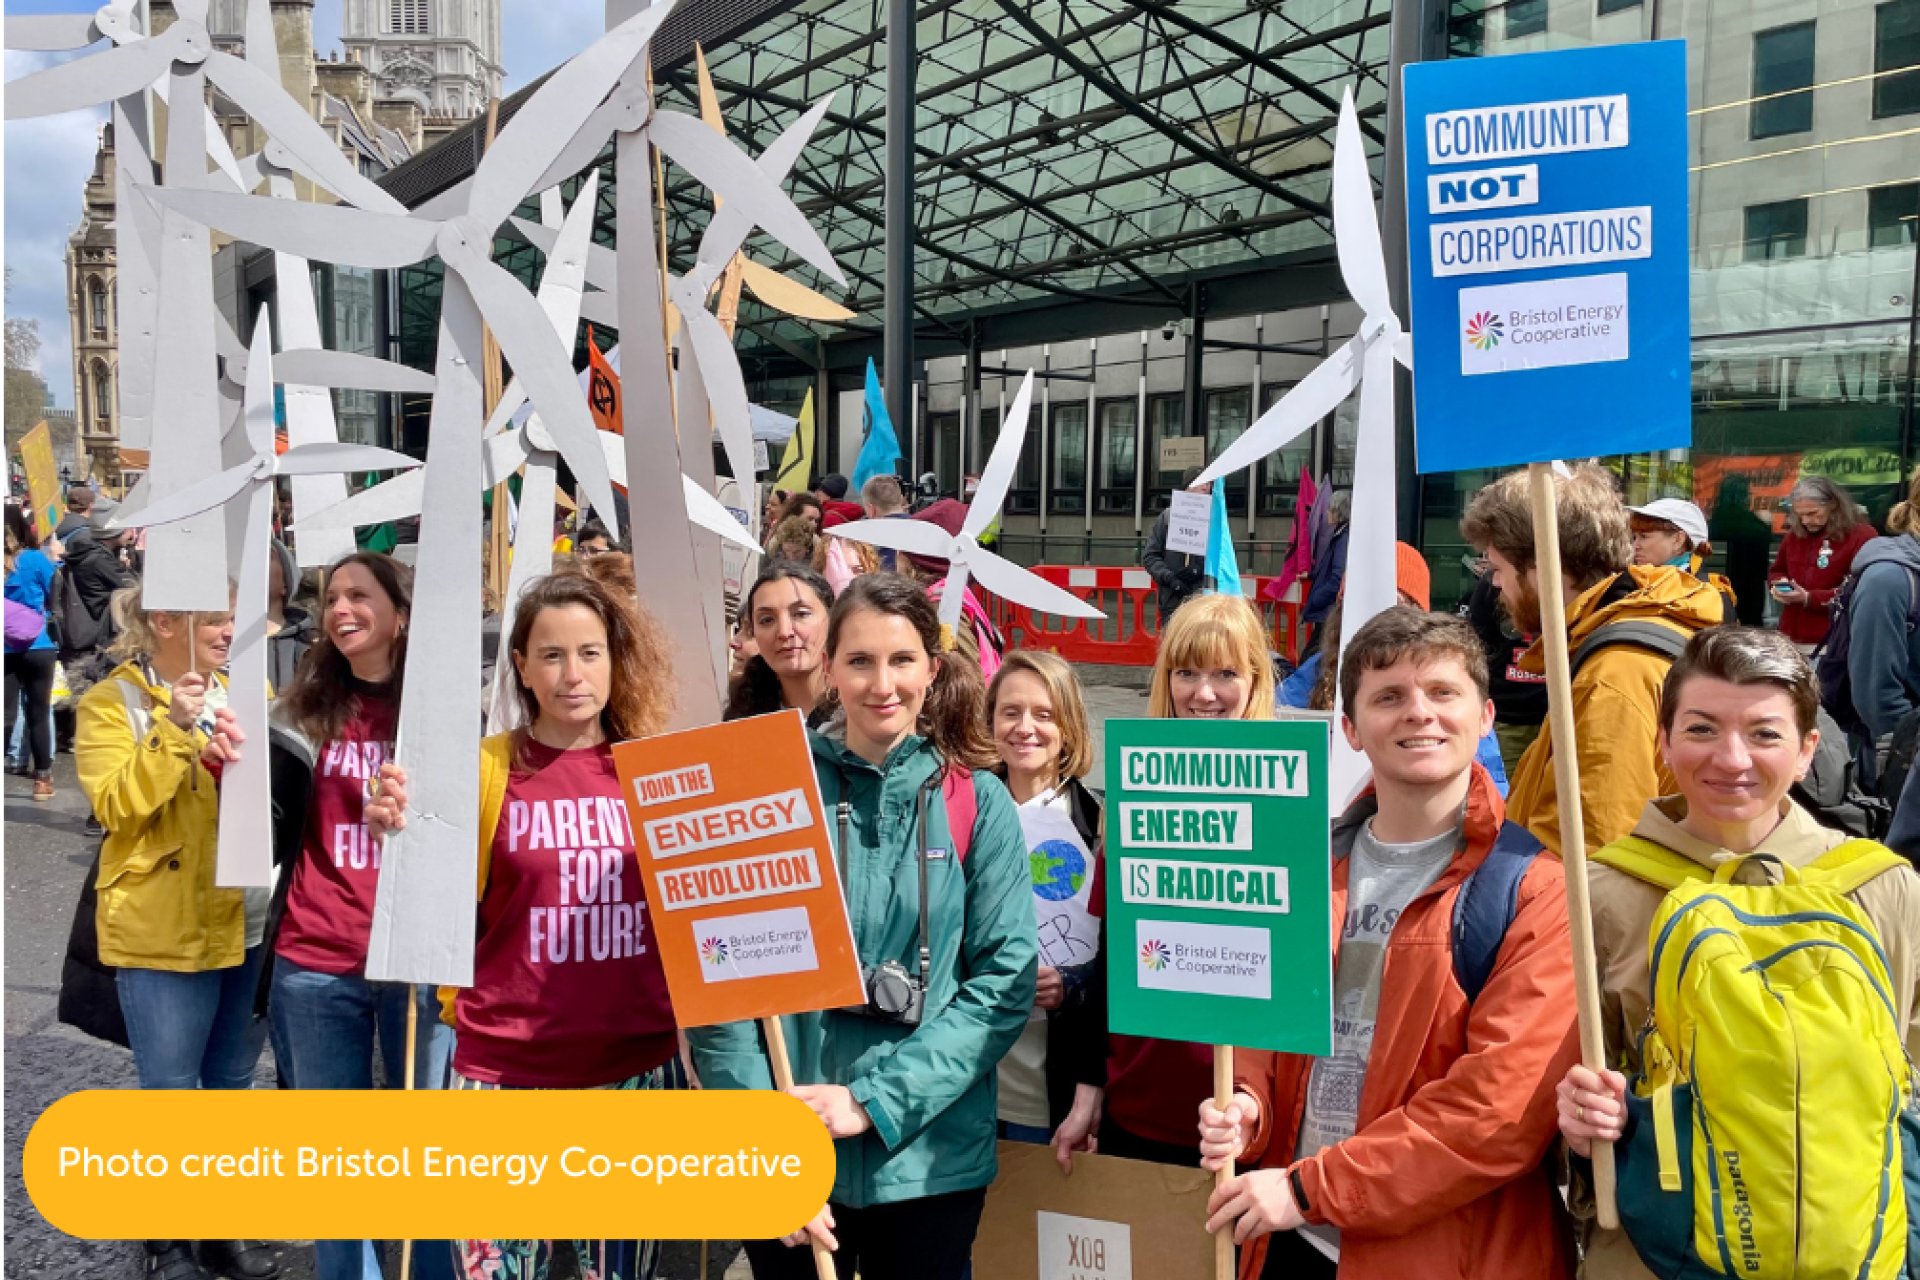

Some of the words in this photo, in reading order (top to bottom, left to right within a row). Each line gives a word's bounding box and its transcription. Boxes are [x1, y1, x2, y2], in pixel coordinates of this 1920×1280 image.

[1434, 102, 1615, 158] COMMUNITY
[1438, 173, 1526, 205] NOT
[1440, 215, 1642, 266] CORPORATIONS
[1509, 306, 1562, 327] Bristol
[1566, 303, 1623, 322] Energy
[1510, 323, 1611, 345] Cooperative
[640, 774, 676, 802] JOIN
[676, 768, 709, 793] THE
[1127, 751, 1300, 790] COMMUNITY
[653, 797, 796, 850] ENERGY
[1130, 809, 1238, 844] ENERGY
[559, 847, 624, 905] FOR
[663, 855, 812, 904] REVOLUTION
[1130, 864, 1150, 898] IS
[1156, 866, 1283, 906] RADICAL
[530, 901, 647, 964] FUTURE
[729, 932, 766, 948] Bristol
[768, 929, 808, 943] Energy
[732, 944, 802, 961] Cooperative
[1175, 943, 1217, 960] Bristol
[1221, 948, 1268, 965] Energy
[1175, 959, 1257, 976] Cooperative
[1723, 1150, 1762, 1272] patagonia
[1068, 1233, 1106, 1272] BOX
